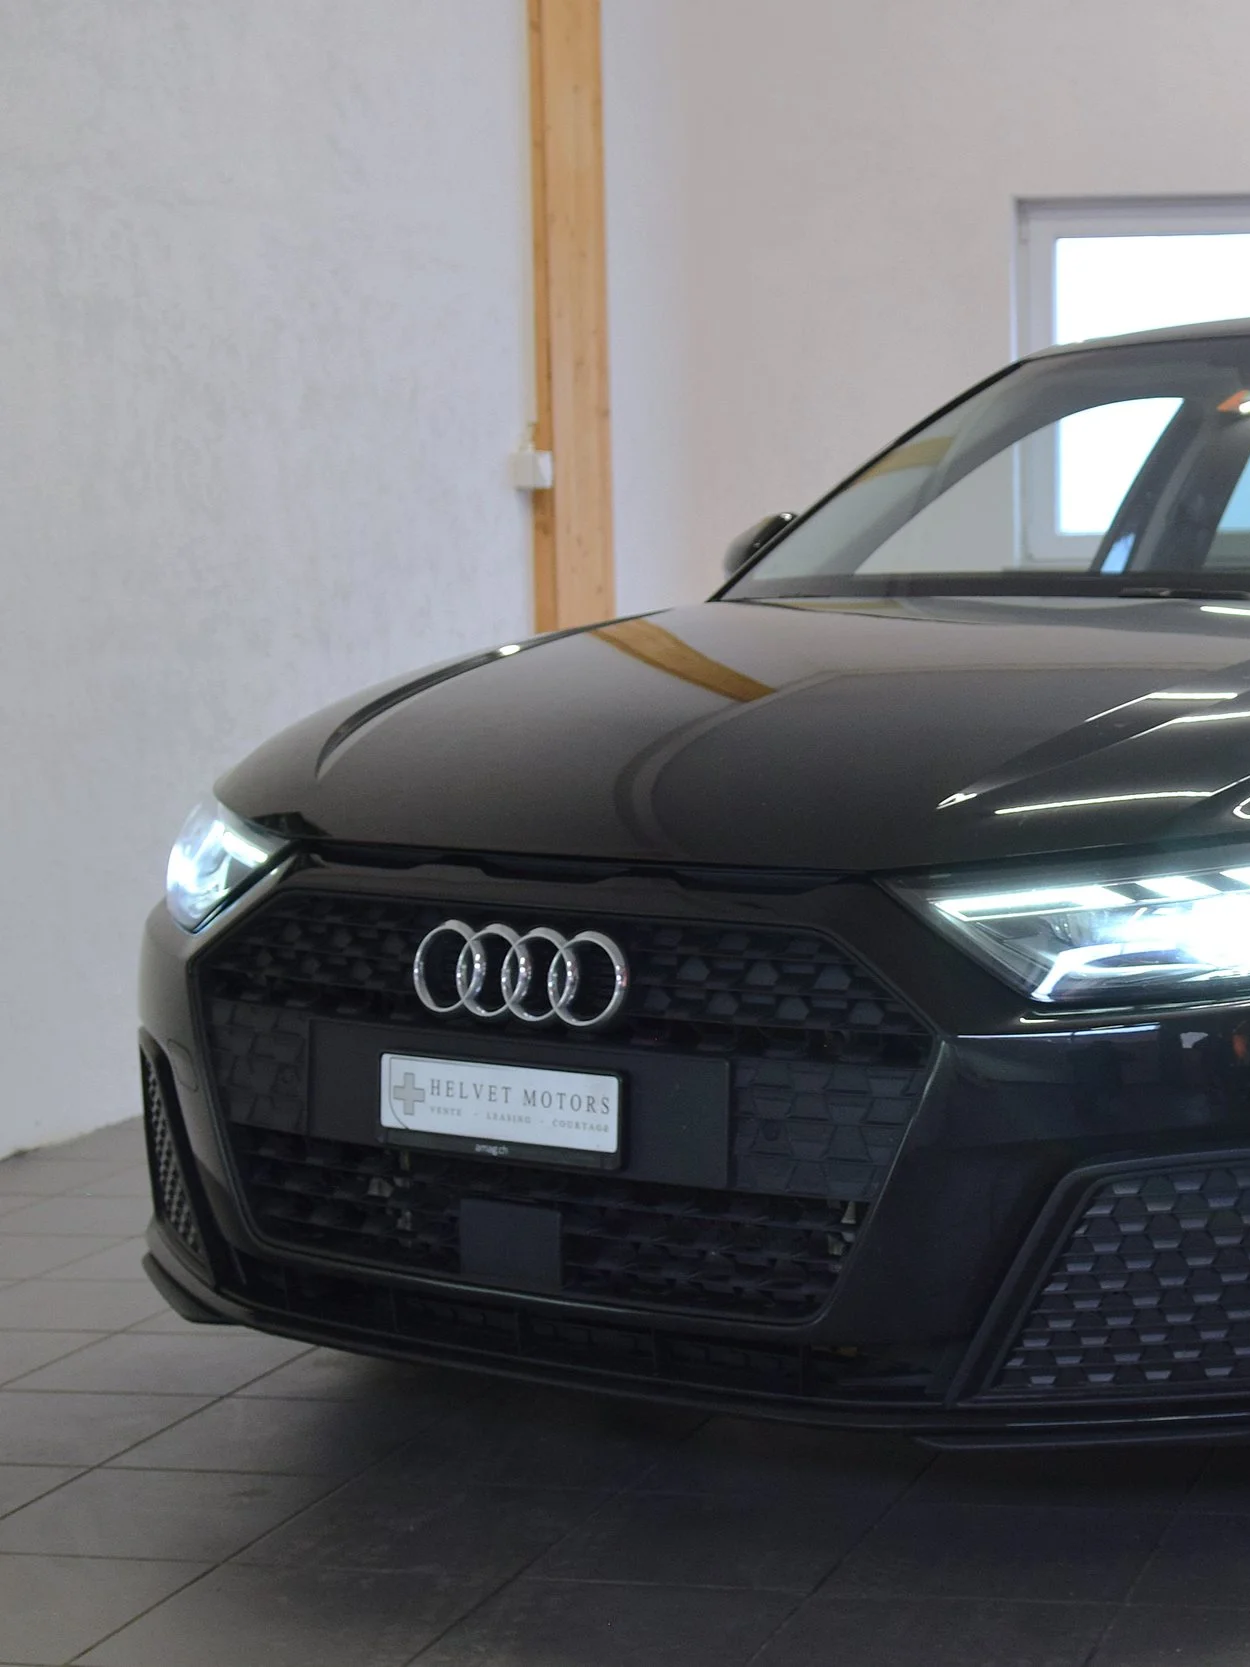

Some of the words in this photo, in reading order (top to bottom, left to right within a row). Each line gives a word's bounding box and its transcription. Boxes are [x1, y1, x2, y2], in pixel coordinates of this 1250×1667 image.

[429, 1078, 512, 1104] HELVET
[522, 1088, 610, 1115] MOTORS
[429, 1105, 462, 1117] VENTE
[486, 1111, 532, 1124] LEASING
[552, 1119, 610, 1133] COURTAGE
